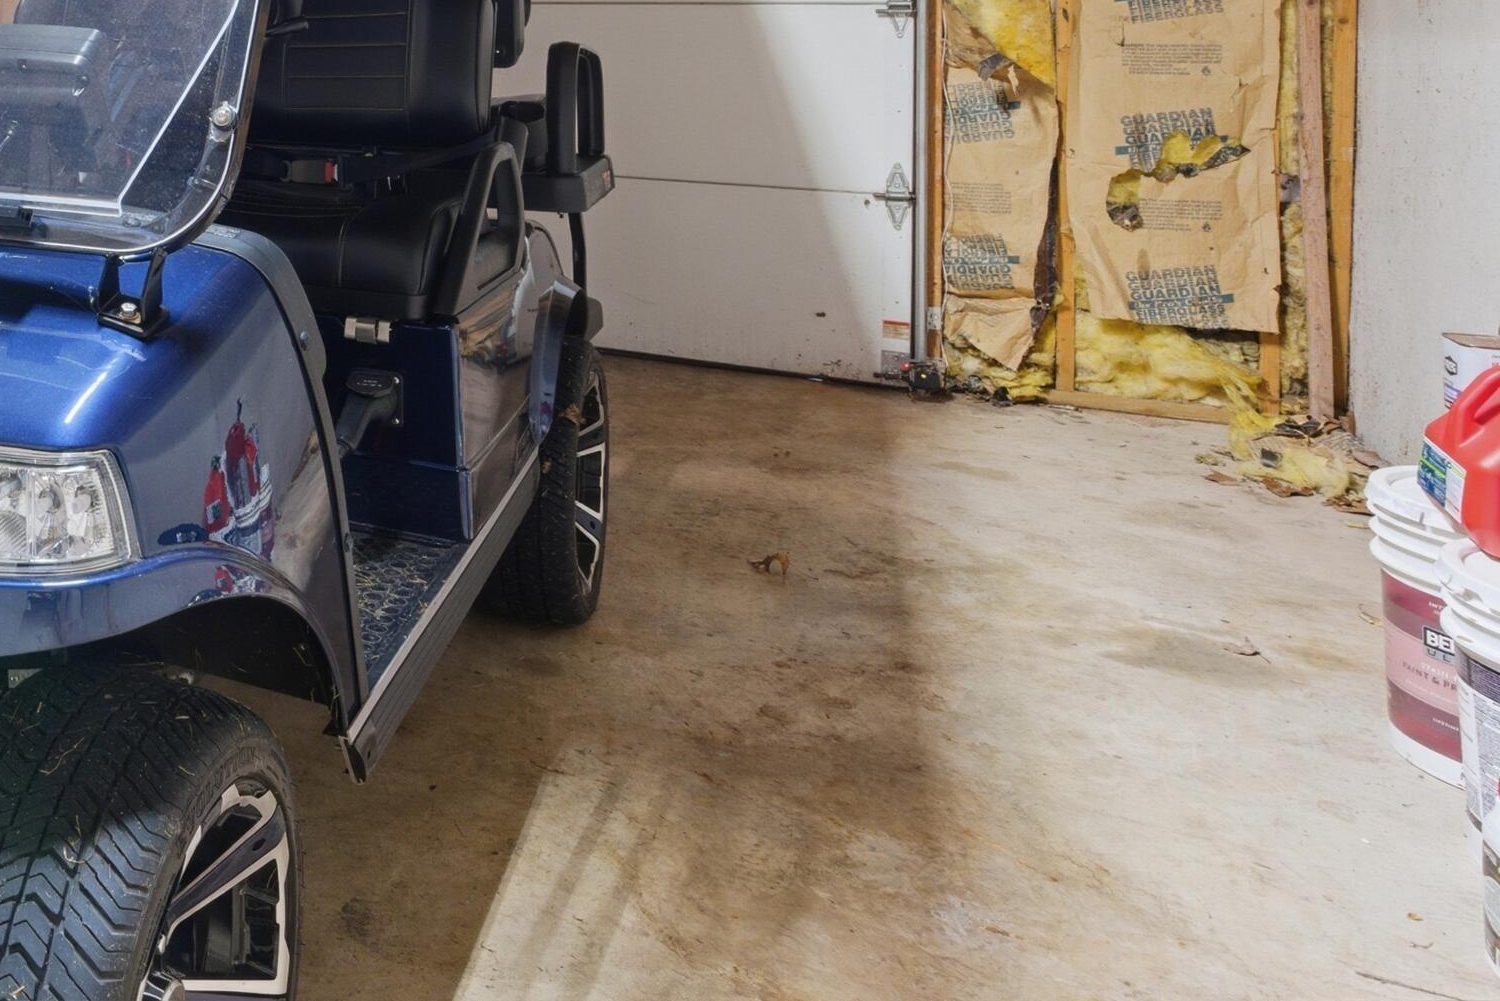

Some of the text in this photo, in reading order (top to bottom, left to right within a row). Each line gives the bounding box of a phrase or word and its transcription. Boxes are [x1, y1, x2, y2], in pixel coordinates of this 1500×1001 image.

[1120, 108, 1213, 127] GUARDIAN
[1125, 126, 1216, 145] GUARAN
[1125, 265, 1215, 283] GUARDIAN
[1130, 284, 1220, 301] GUARDIAN
[1136, 304, 1226, 321] FIBERGLASS
